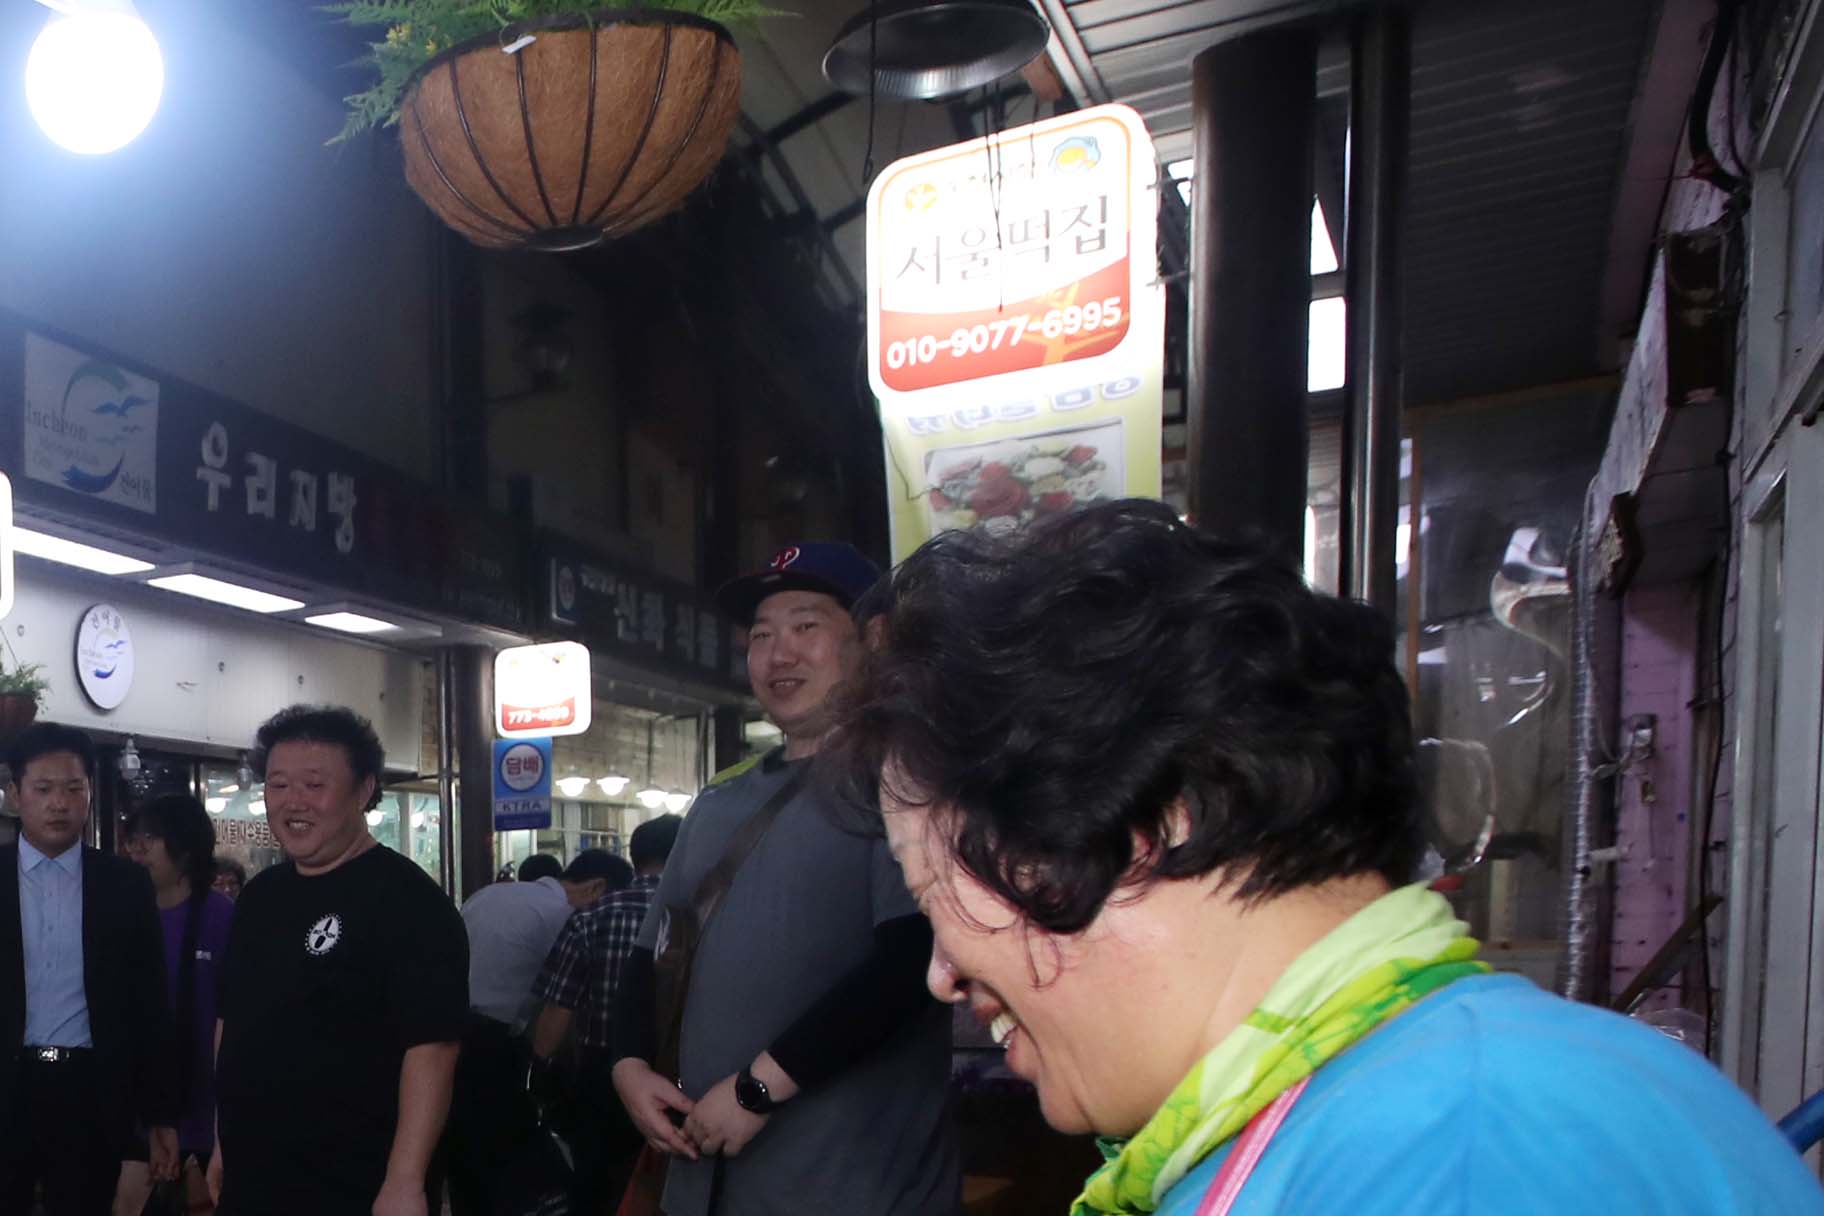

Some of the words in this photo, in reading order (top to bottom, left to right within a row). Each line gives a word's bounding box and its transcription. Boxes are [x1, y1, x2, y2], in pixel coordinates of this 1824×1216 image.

[896, 193, 1109, 285] 서울떡집
[886, 295, 1122, 369] 010-9077-6995
[506, 756, 540, 776] 담배
